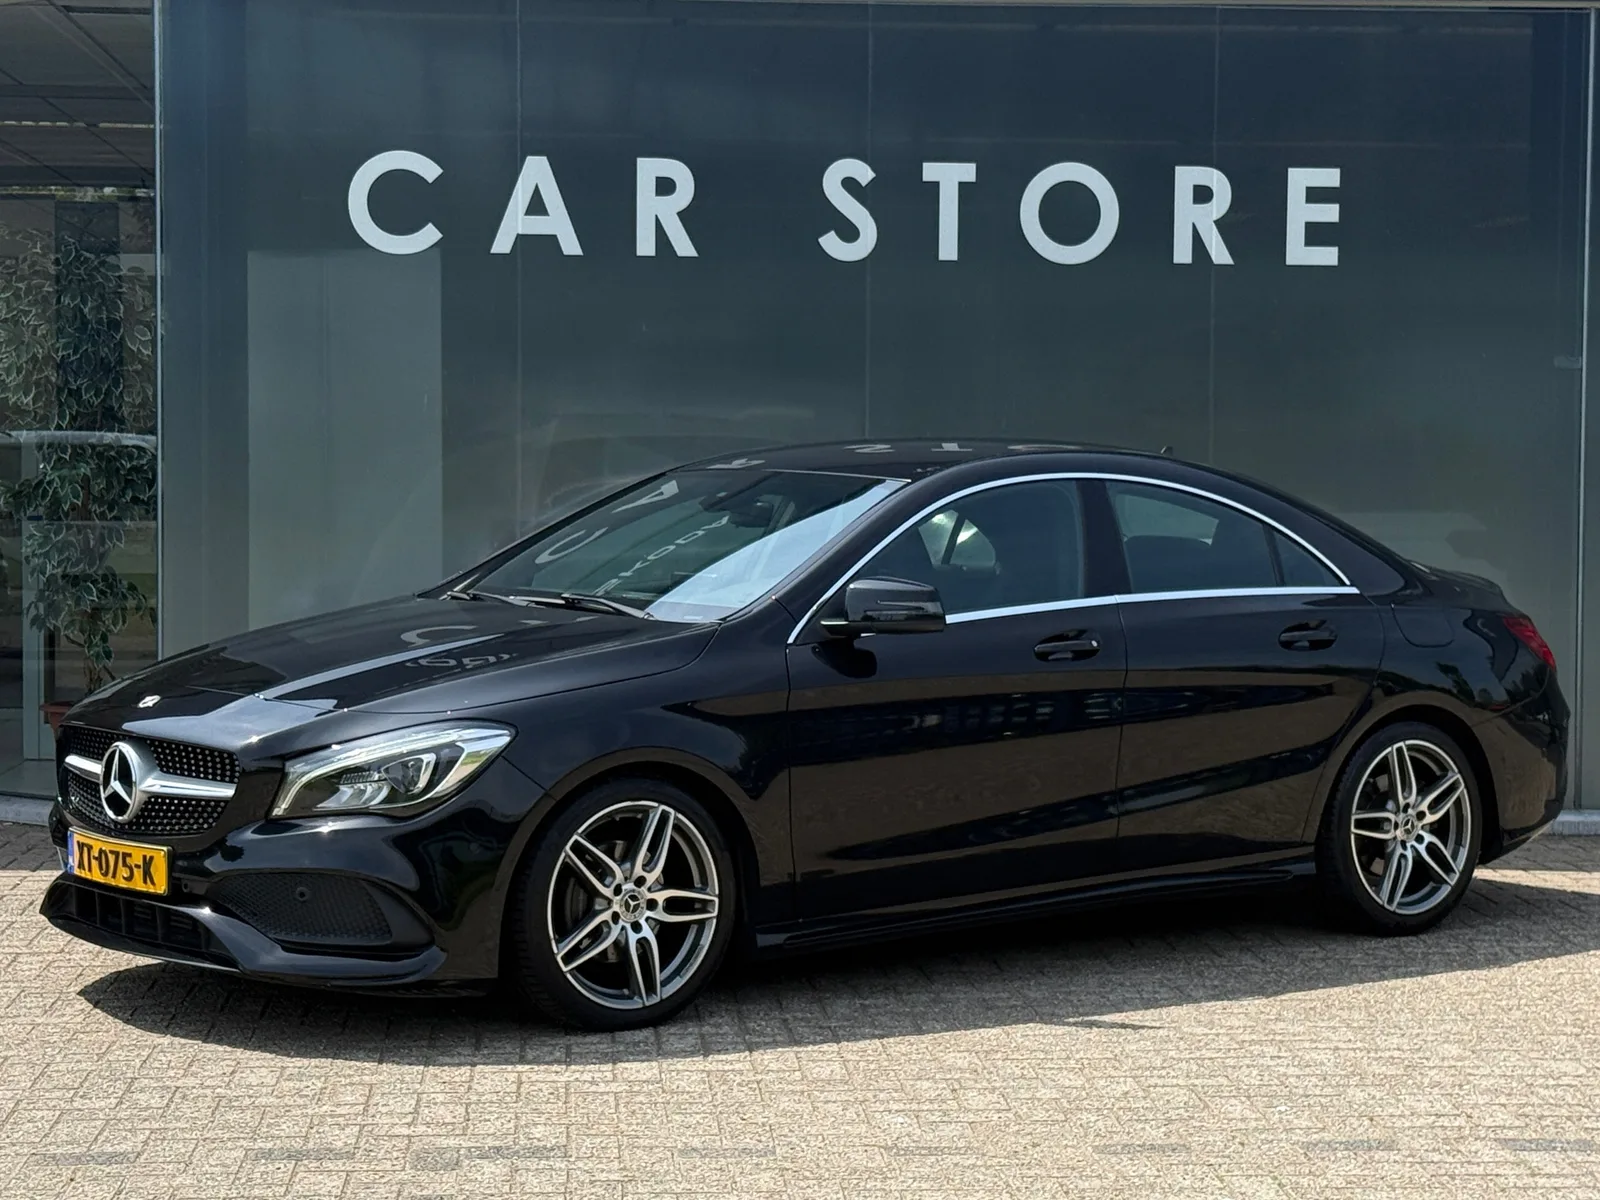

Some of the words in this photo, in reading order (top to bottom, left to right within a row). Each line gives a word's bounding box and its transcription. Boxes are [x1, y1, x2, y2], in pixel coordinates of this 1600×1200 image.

[348, 150, 698, 257] CAR
[818, 158, 1341, 266] STORE
[76, 840, 156, 887] XT-075-K
